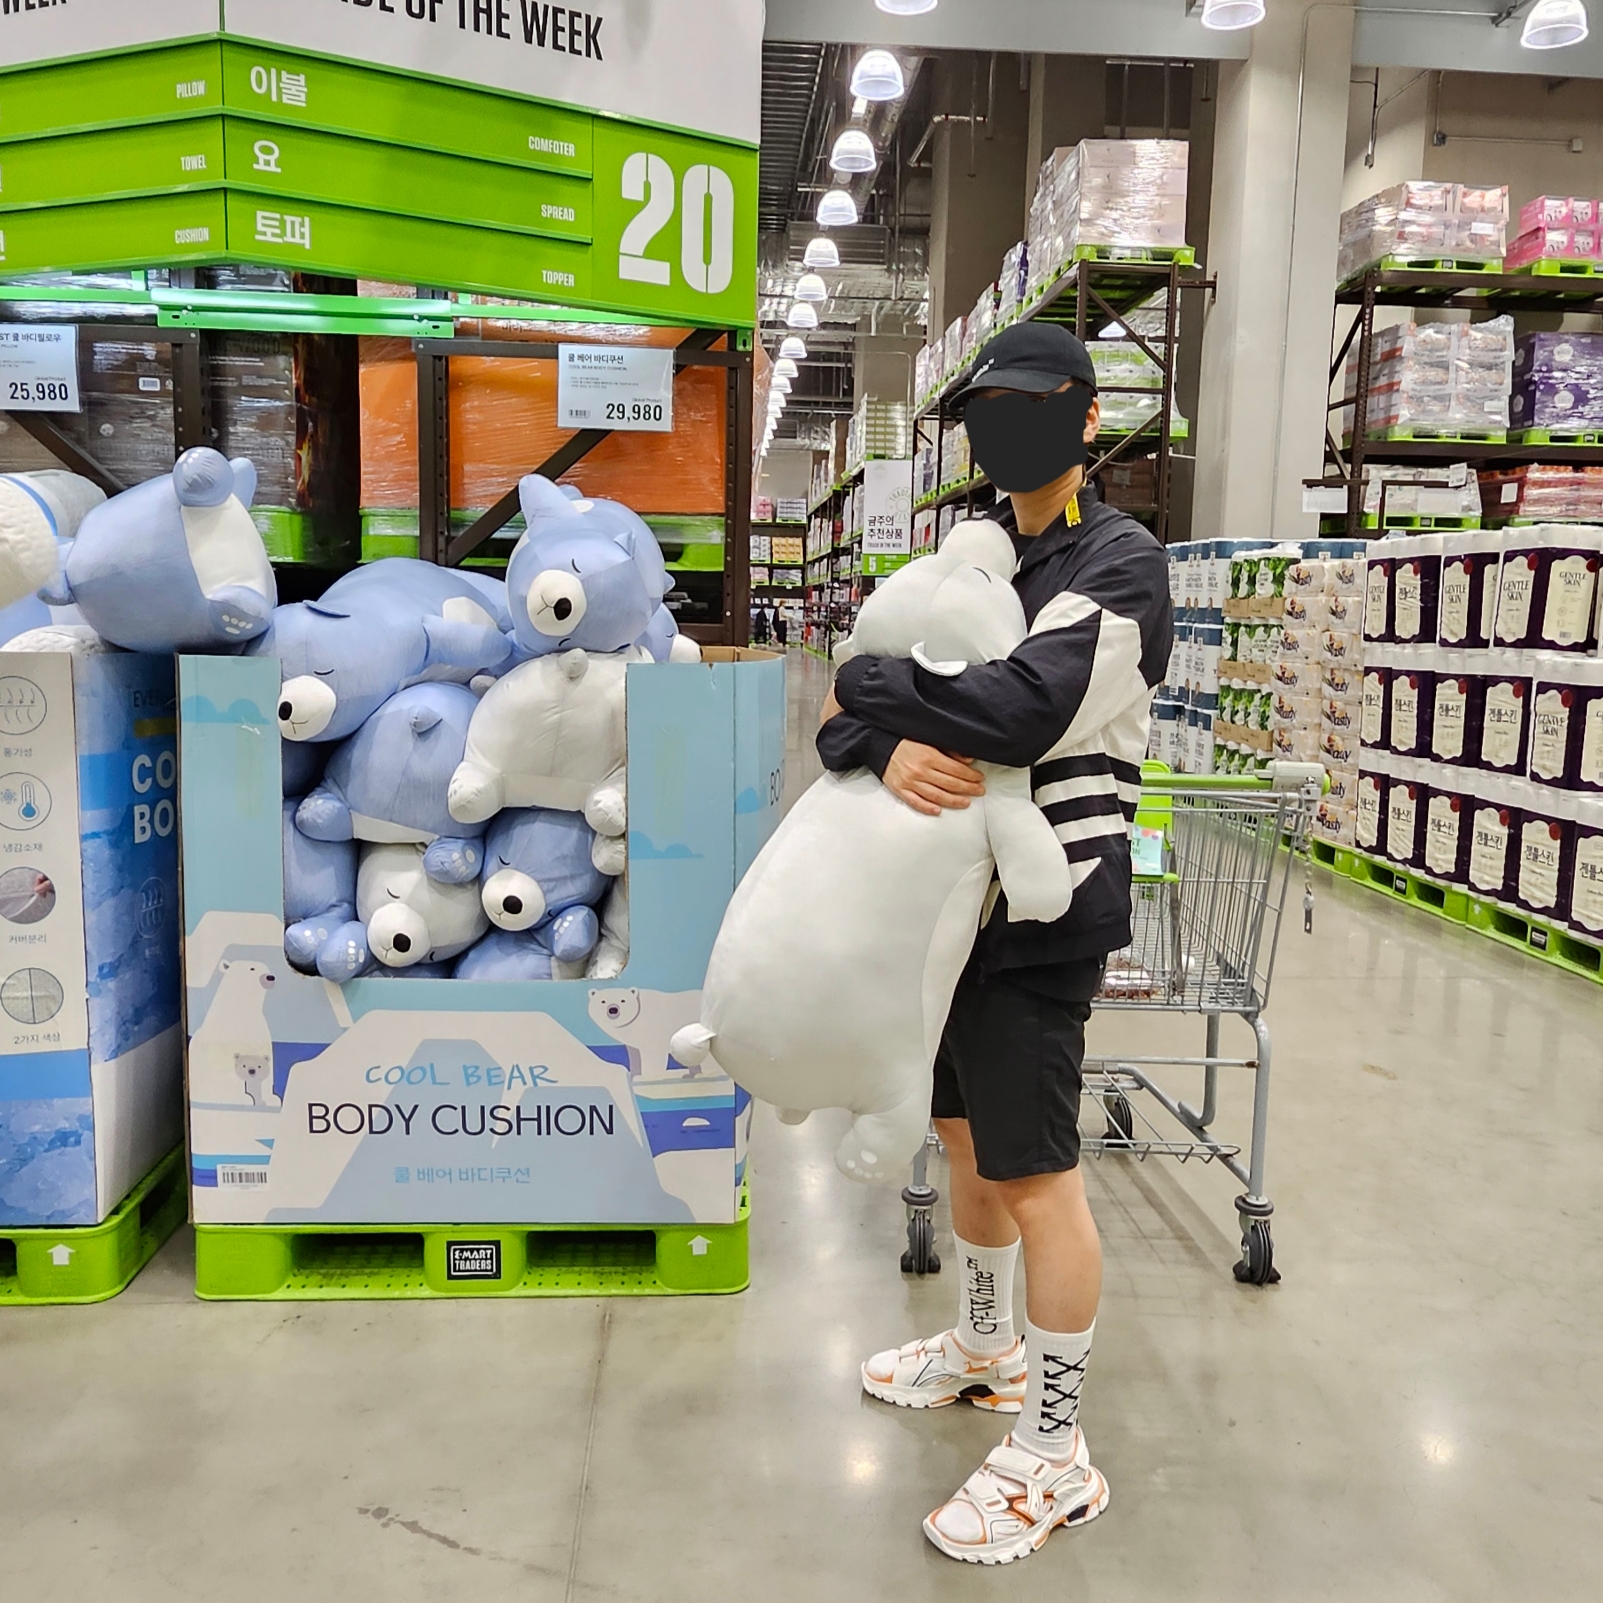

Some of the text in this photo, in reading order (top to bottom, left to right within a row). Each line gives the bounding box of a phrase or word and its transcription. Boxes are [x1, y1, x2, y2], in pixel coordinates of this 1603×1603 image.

[458, 0, 511, 40] THE
[519, 0, 604, 61] WEEK
[176, 80, 206, 99] PILLOW
[250, 65, 308, 107] 이불
[528, 135, 575, 157] COMFOTER
[180, 154, 207, 171] TOWEL
[252, 140, 282, 173] 요
[541, 204, 575, 222] SPREAD
[255, 210, 311, 249] 토퍼
[618, 151, 735, 294] 20
[174, 227, 209, 244] CUSHION
[542, 270, 575, 287] TOPPER
[12, 333, 20, 342] 쿨
[21, 333, 62, 343] 바디필로우
[568, 353, 624, 365] 쿨 베어 바디쿠션
[9, 382, 69, 403] 25,980
[606, 403, 663, 423] 29,980
[868, 515, 894, 526] 금주의
[867, 528, 903, 539] 추천상품
[868, 556, 877, 573] 5
[1559, 571, 1587, 580] GENTLE
[1564, 579, 1581, 587] SKIN
[1445, 584, 1466, 594] GENTLE
[1503, 580, 1530, 591] GENTLE
[1448, 594, 1461, 604] SKIN
[1507, 591, 1523, 601] SKIN
[1438, 703, 1462, 718] 젠틀스킨
[1488, 708, 1517, 724] 젠틀스킨
[1538, 713, 1566, 727] GENTLE
[1542, 725, 1559, 738] SKIN
[1431, 818, 1455, 836] 젠틀스킨
[3, 842, 43, 852] 냉감소재
[1475, 831, 1503, 850] 젠틀스킨
[1524, 845, 1555, 867] 젠틀스킨
[9, 934, 47, 944] 커버분리
[13, 1032, 61, 1044] 2가지 색상
[365, 1063, 558, 1090] COOL BEAR
[307, 1103, 614, 1135] BODY CUSHION
[393, 1166, 531, 1184] 쿨 베어 바디쿠션
[455, 1260, 492, 1270] TRADERS
